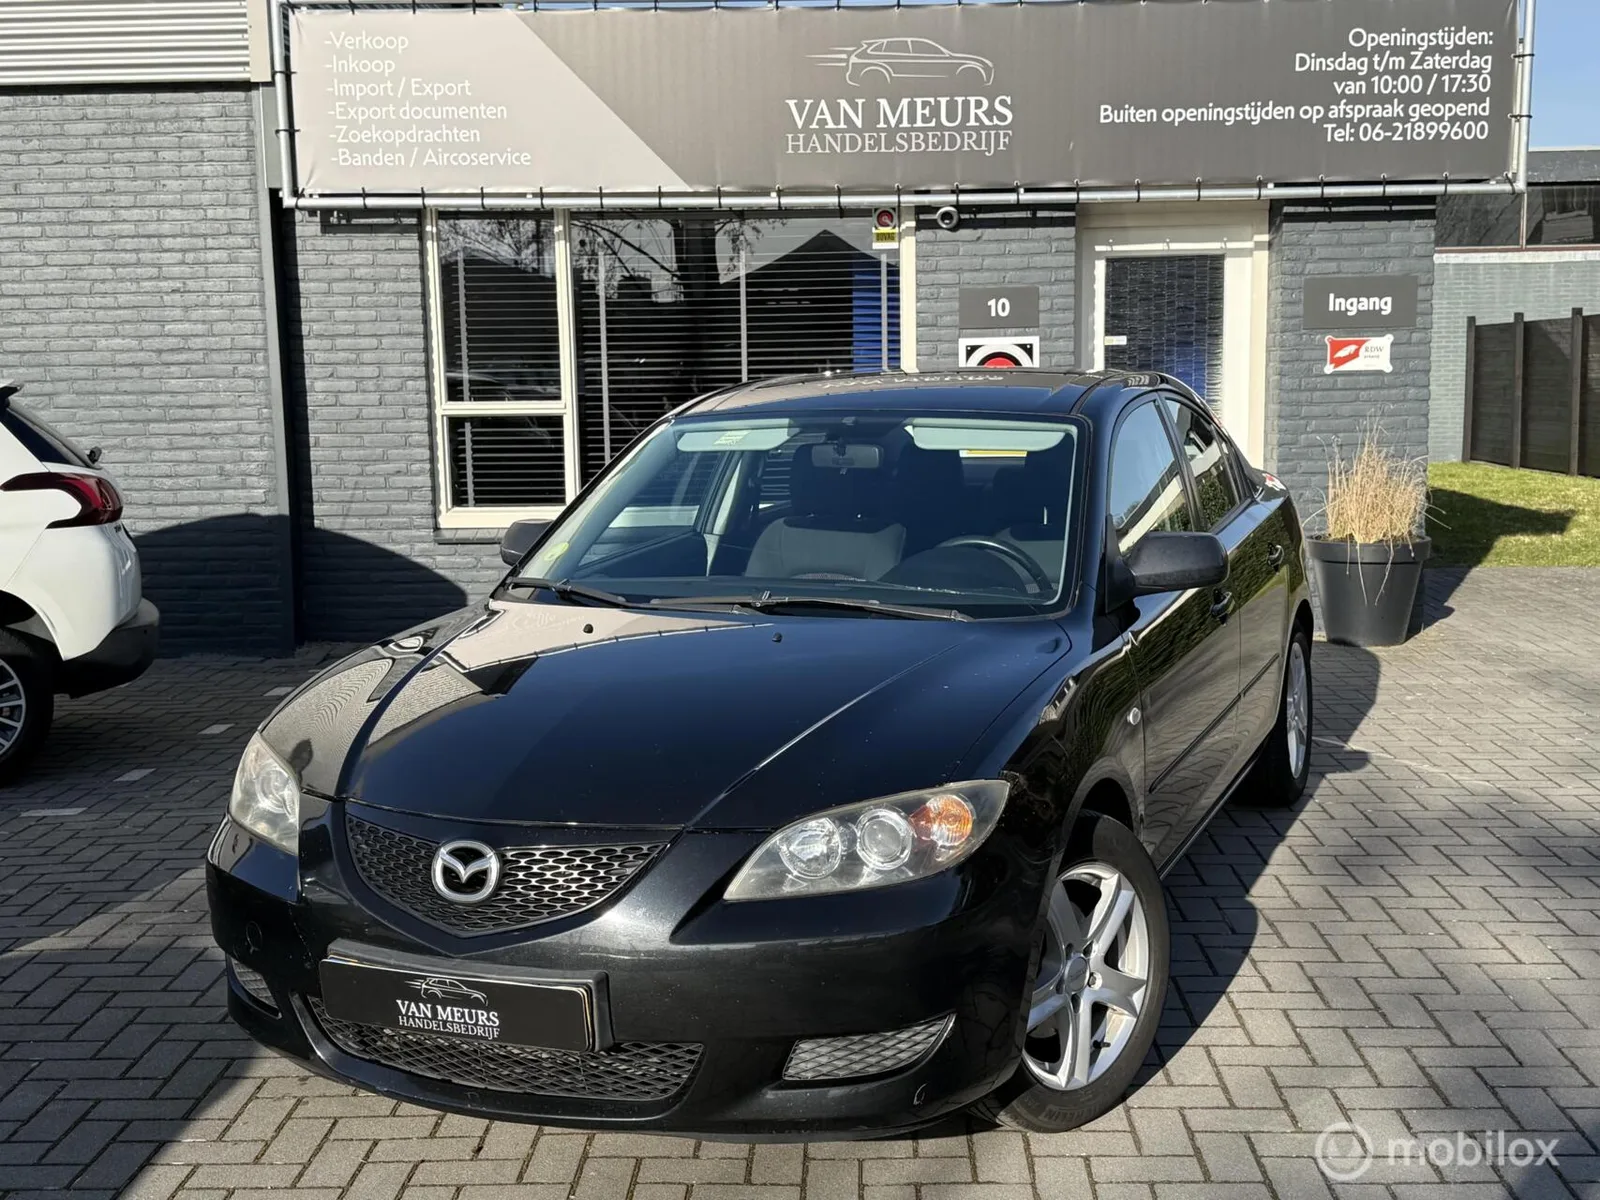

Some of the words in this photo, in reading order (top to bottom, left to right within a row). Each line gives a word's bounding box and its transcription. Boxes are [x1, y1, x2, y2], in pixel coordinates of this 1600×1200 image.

[324, 30, 409, 54] -Verkoop
[1348, 25, 1494, 51] Openingstijden:
[324, 54, 396, 77] -Inkoop
[1295, 51, 1369, 76] Dinsdag
[1372, 50, 1405, 73] t/m
[1409, 50, 1493, 74] Zaterdag
[326, 78, 394, 101] -Import
[397, 77, 406, 99] /
[411, 78, 472, 101] Export
[1333, 80, 1366, 95] van
[1370, 74, 1423, 94] 10:00
[1426, 73, 1438, 96] /
[1441, 73, 1491, 93] 17:30
[327, 101, 396, 124] -Export
[399, 100, 507, 120] documenten
[784, 98, 866, 130] VAN
[876, 95, 1013, 129] MEURS
[1099, 104, 1157, 124] Buiten
[1161, 101, 1295, 127] openingstijden
[1299, 105, 1325, 122] op
[1327, 99, 1405, 121] afspraak
[1408, 96, 1490, 120] geopend
[329, 123, 481, 147] -Zoekopdrachten
[1323, 122, 1355, 142] Tel:
[1358, 119, 1489, 142] 06-21899600
[786, 130, 1013, 157] HANDELSBEDRIJF
[330, 147, 405, 166] -Banden
[409, 146, 419, 168] /
[422, 147, 531, 166] Aircoservice
[987, 297, 1011, 317] 10
[1328, 293, 1393, 316] Ingang
[1364, 345, 1385, 353] RDW
[396, 999, 432, 1018] VAN
[437, 1005, 499, 1027] MEURS
[398, 1015, 500, 1040] HANDELSBEDRIJF
